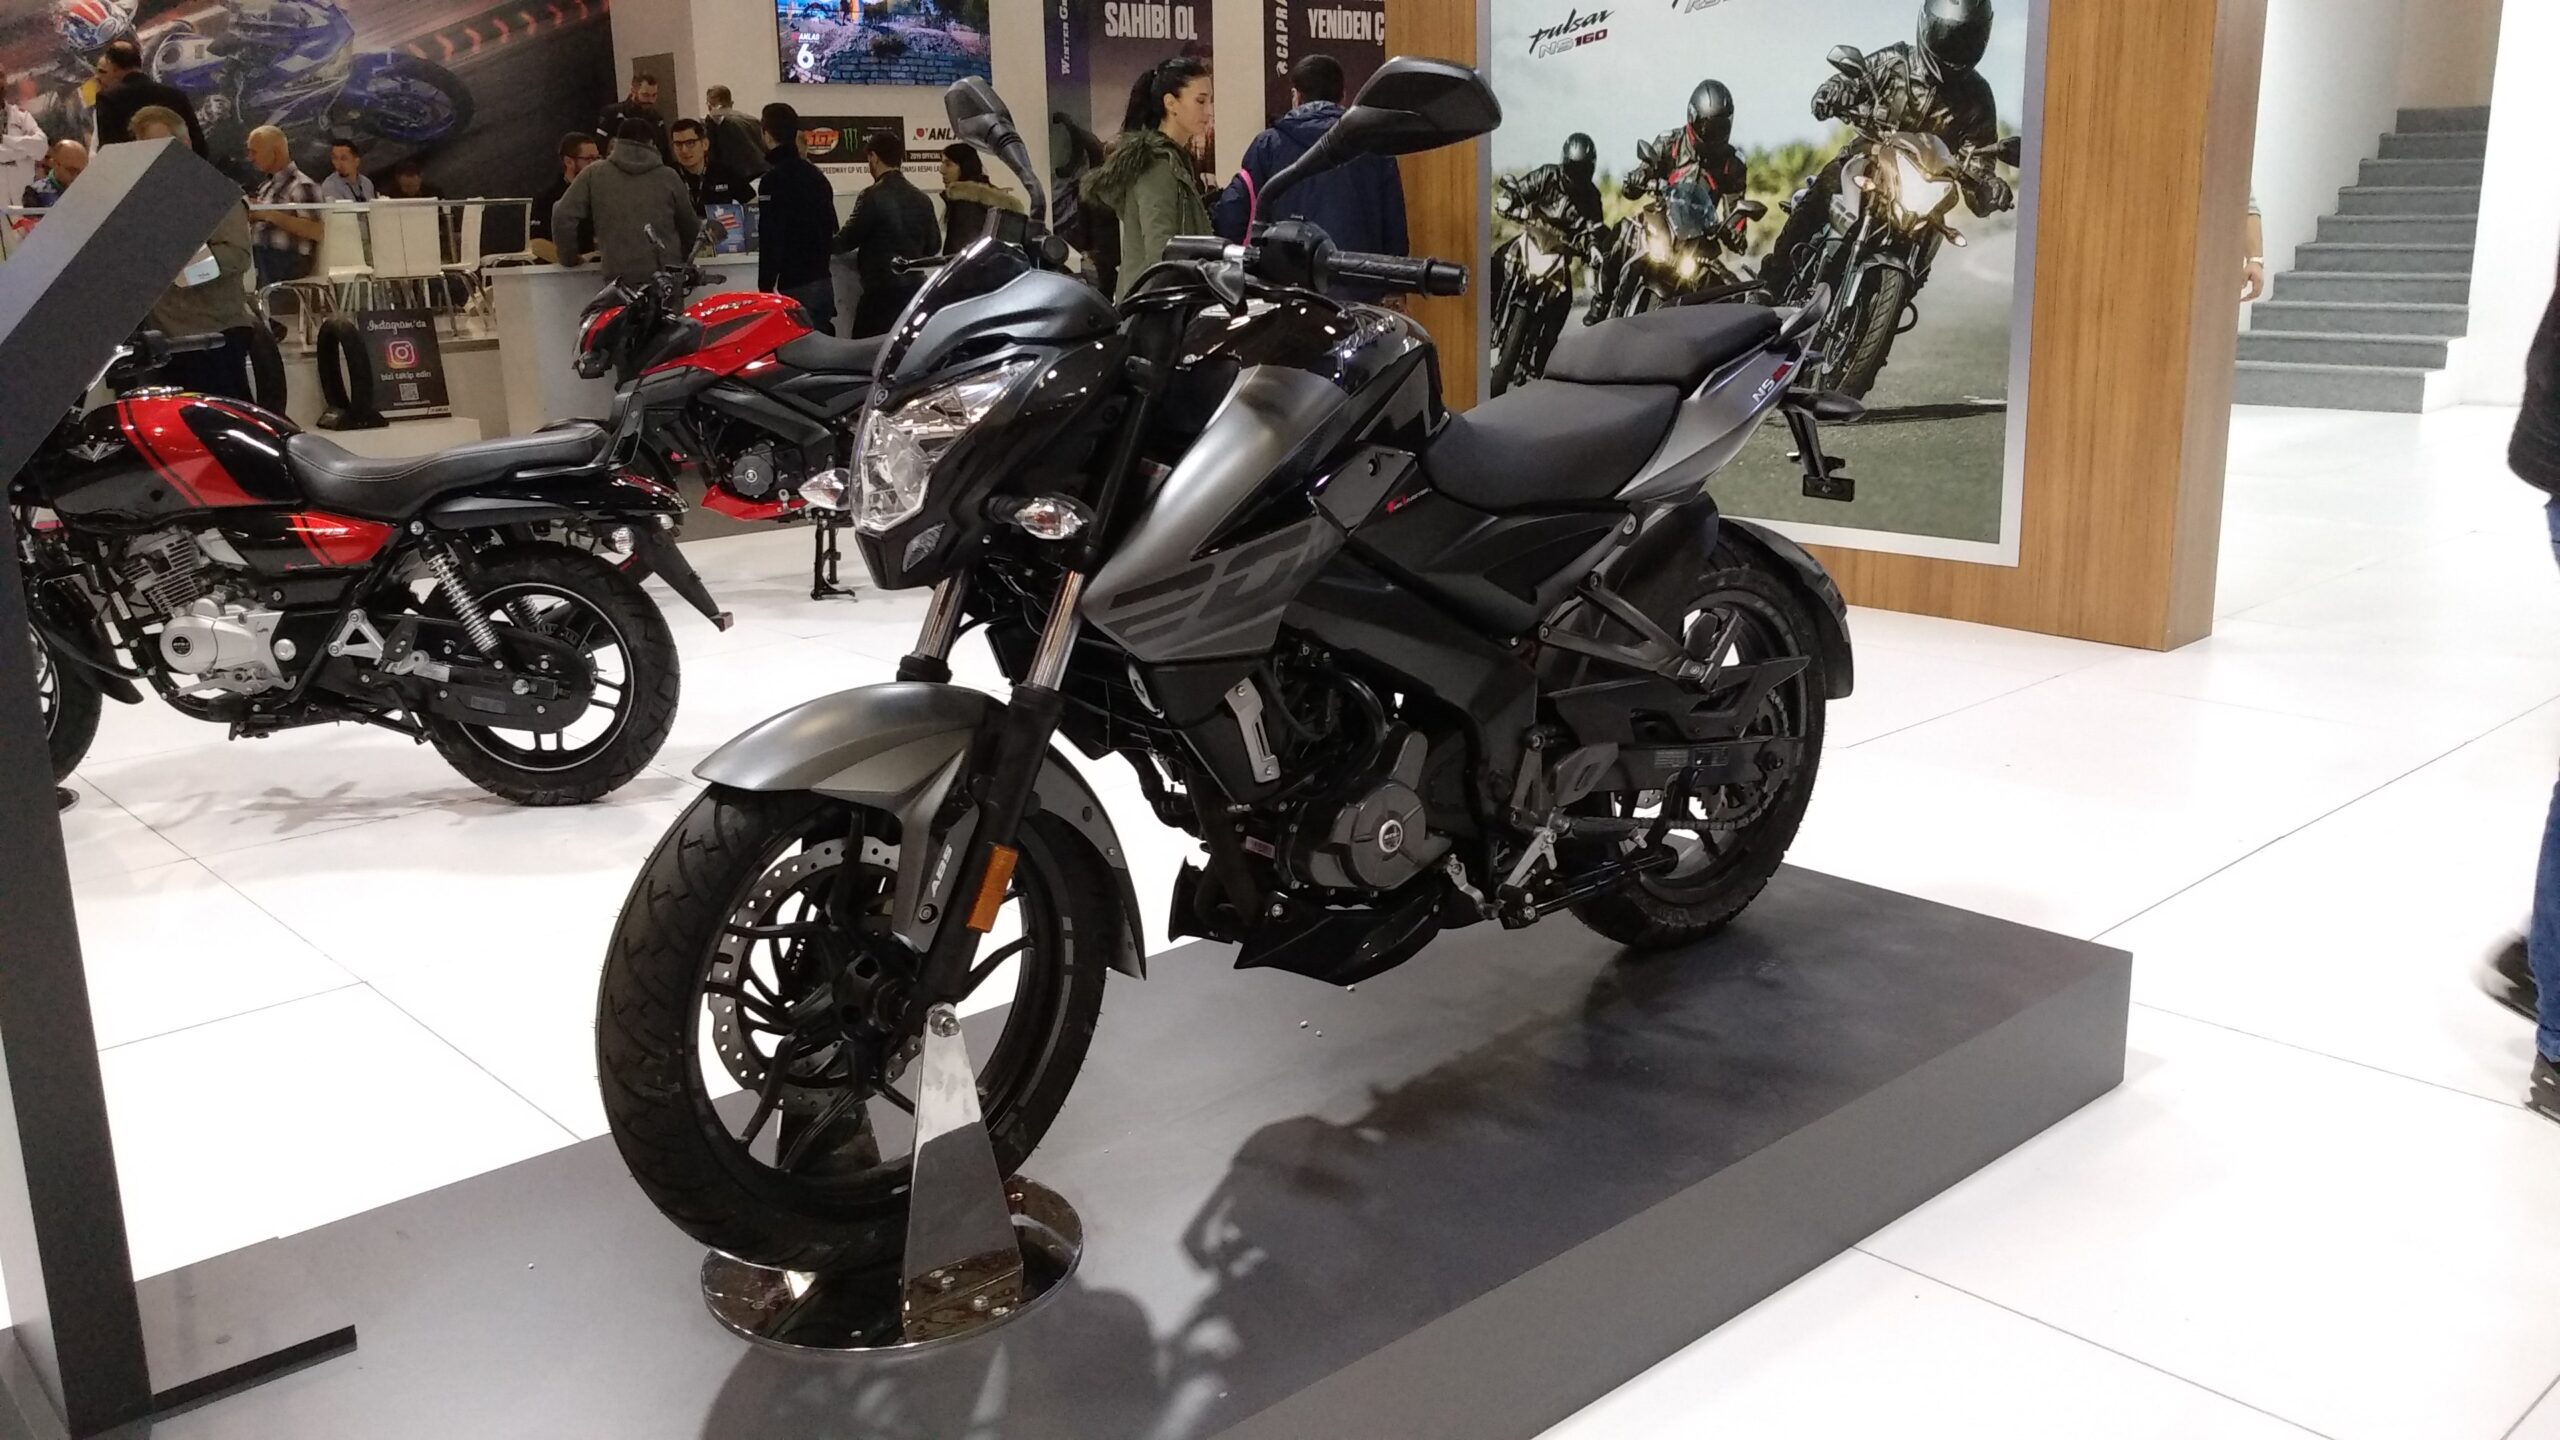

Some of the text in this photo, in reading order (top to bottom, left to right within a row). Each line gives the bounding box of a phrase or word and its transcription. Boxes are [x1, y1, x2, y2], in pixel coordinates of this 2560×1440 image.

[1104, 0, 1198, 41] SAHİBİ OL
[1307, 5, 1372, 40] YENİDEN
[797, 43, 815, 69] 6
[1538, 28, 1609, 59] NS160
[395, 370, 415, 381] takip
[416, 370, 432, 379] edin
[932, 843, 953, 898] ABS
